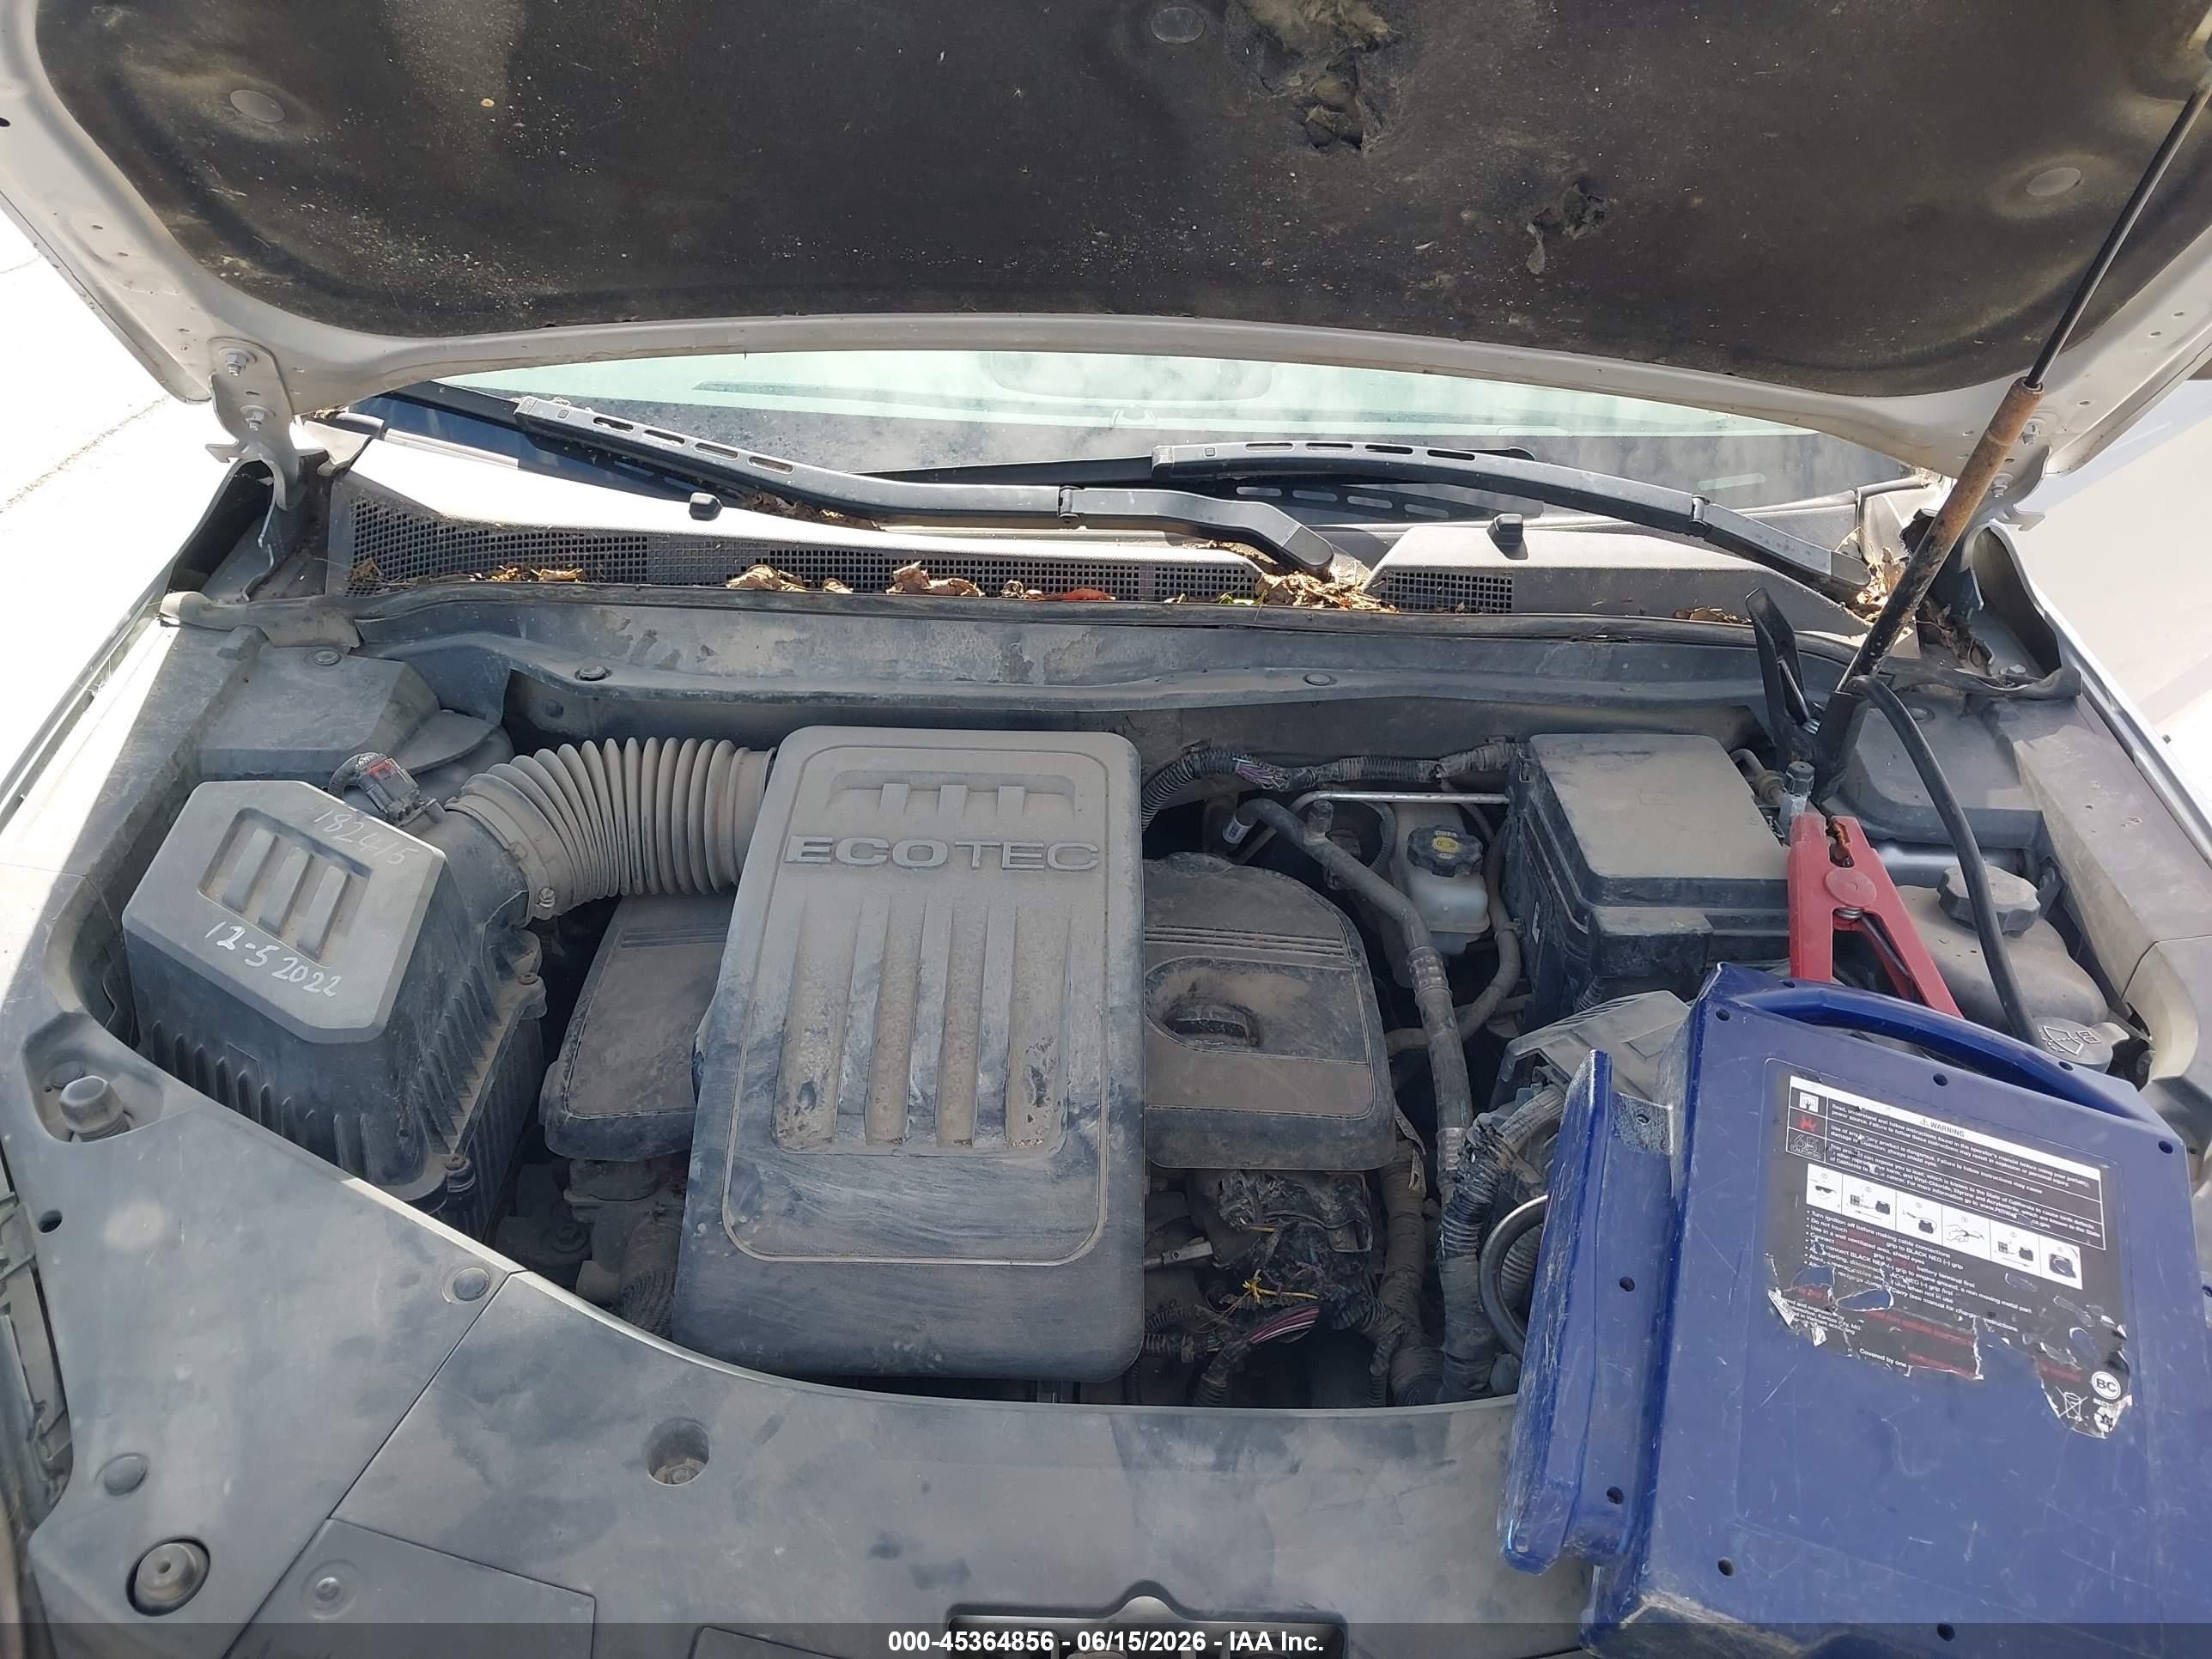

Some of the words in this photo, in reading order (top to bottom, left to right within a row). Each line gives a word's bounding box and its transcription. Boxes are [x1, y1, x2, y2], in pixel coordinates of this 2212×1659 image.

[784, 836, 1099, 872] ECOTEC
[1930, 1121, 1964, 1137] WARNING
[1825, 1215, 1845, 1225] ignition
[1856, 1224, 1874, 1234] before
[1875, 1231, 1896, 1243] making
[1898, 1238, 1913, 1247] cable
[1915, 1244, 1950, 1258] connections
[1832, 1224, 1847, 1233] touch
[1906, 1248, 1926, 1258] BLACK
[1847, 1237, 1875, 1249] ventilated
[1893, 1251, 1910, 1260] shield
[1810, 1232, 1834, 1243] Connect
[1917, 1265, 1937, 1277] battery
[1963, 1279, 1975, 1288] first
[1826, 1245, 1848, 1255] connect
[1850, 1252, 1870, 1262] BLACK
[1915, 1273, 1935, 1283] engine
[1859, 1347, 1884, 1361] Covered
[1886, 1356, 1893, 1365] by
[2096, 1377, 2116, 1393] BC
